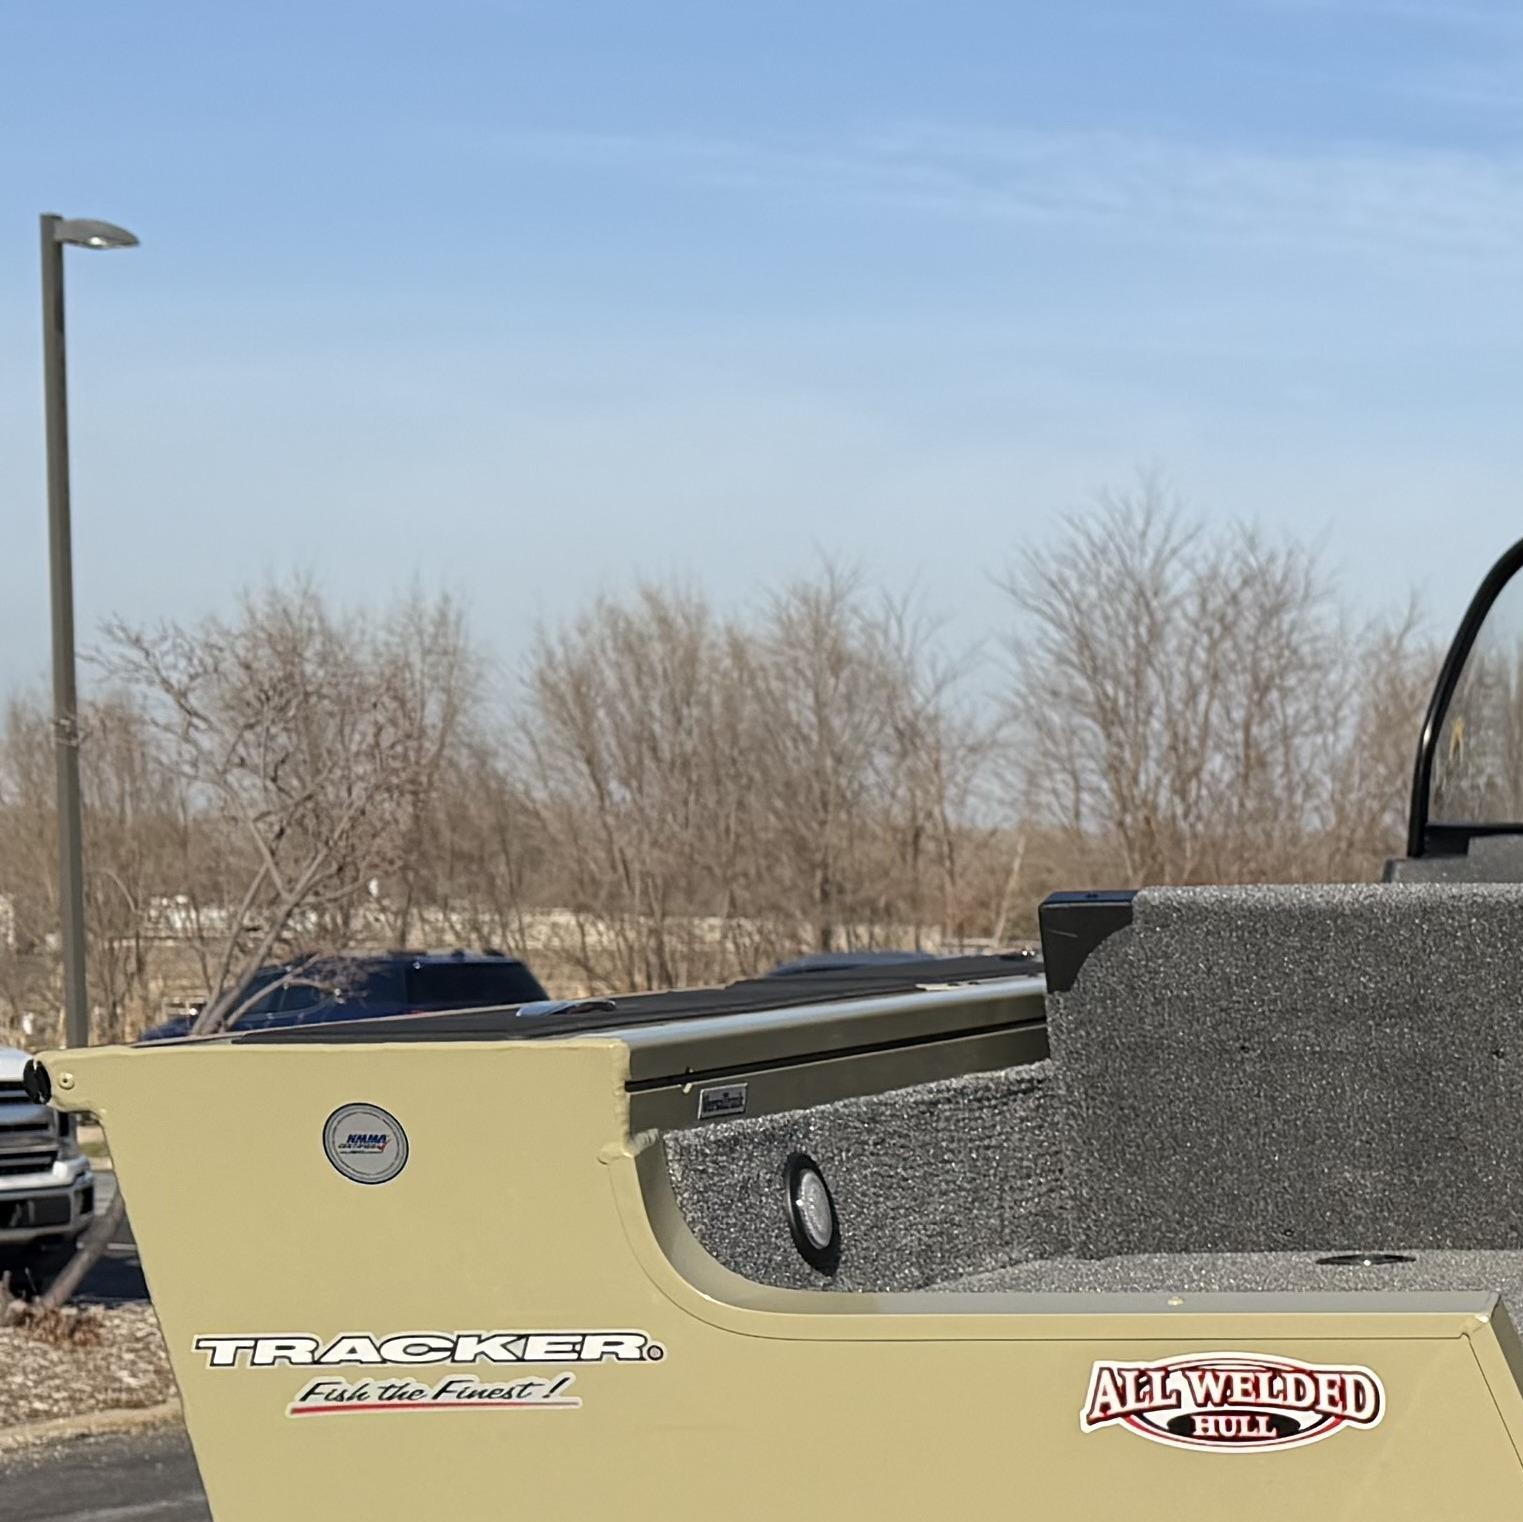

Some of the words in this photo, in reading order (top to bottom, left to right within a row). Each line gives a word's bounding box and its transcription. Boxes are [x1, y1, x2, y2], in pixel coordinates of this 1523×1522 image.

[196, 1332, 648, 1367] TRACKER
[299, 1380, 370, 1403] Fish
[377, 1379, 426, 1402] the
[432, 1376, 534, 1402] Finest
[1088, 1366, 1182, 1426] ALL
[1185, 1365, 1381, 1425] WELDED
[1190, 1415, 1277, 1437] HULL
